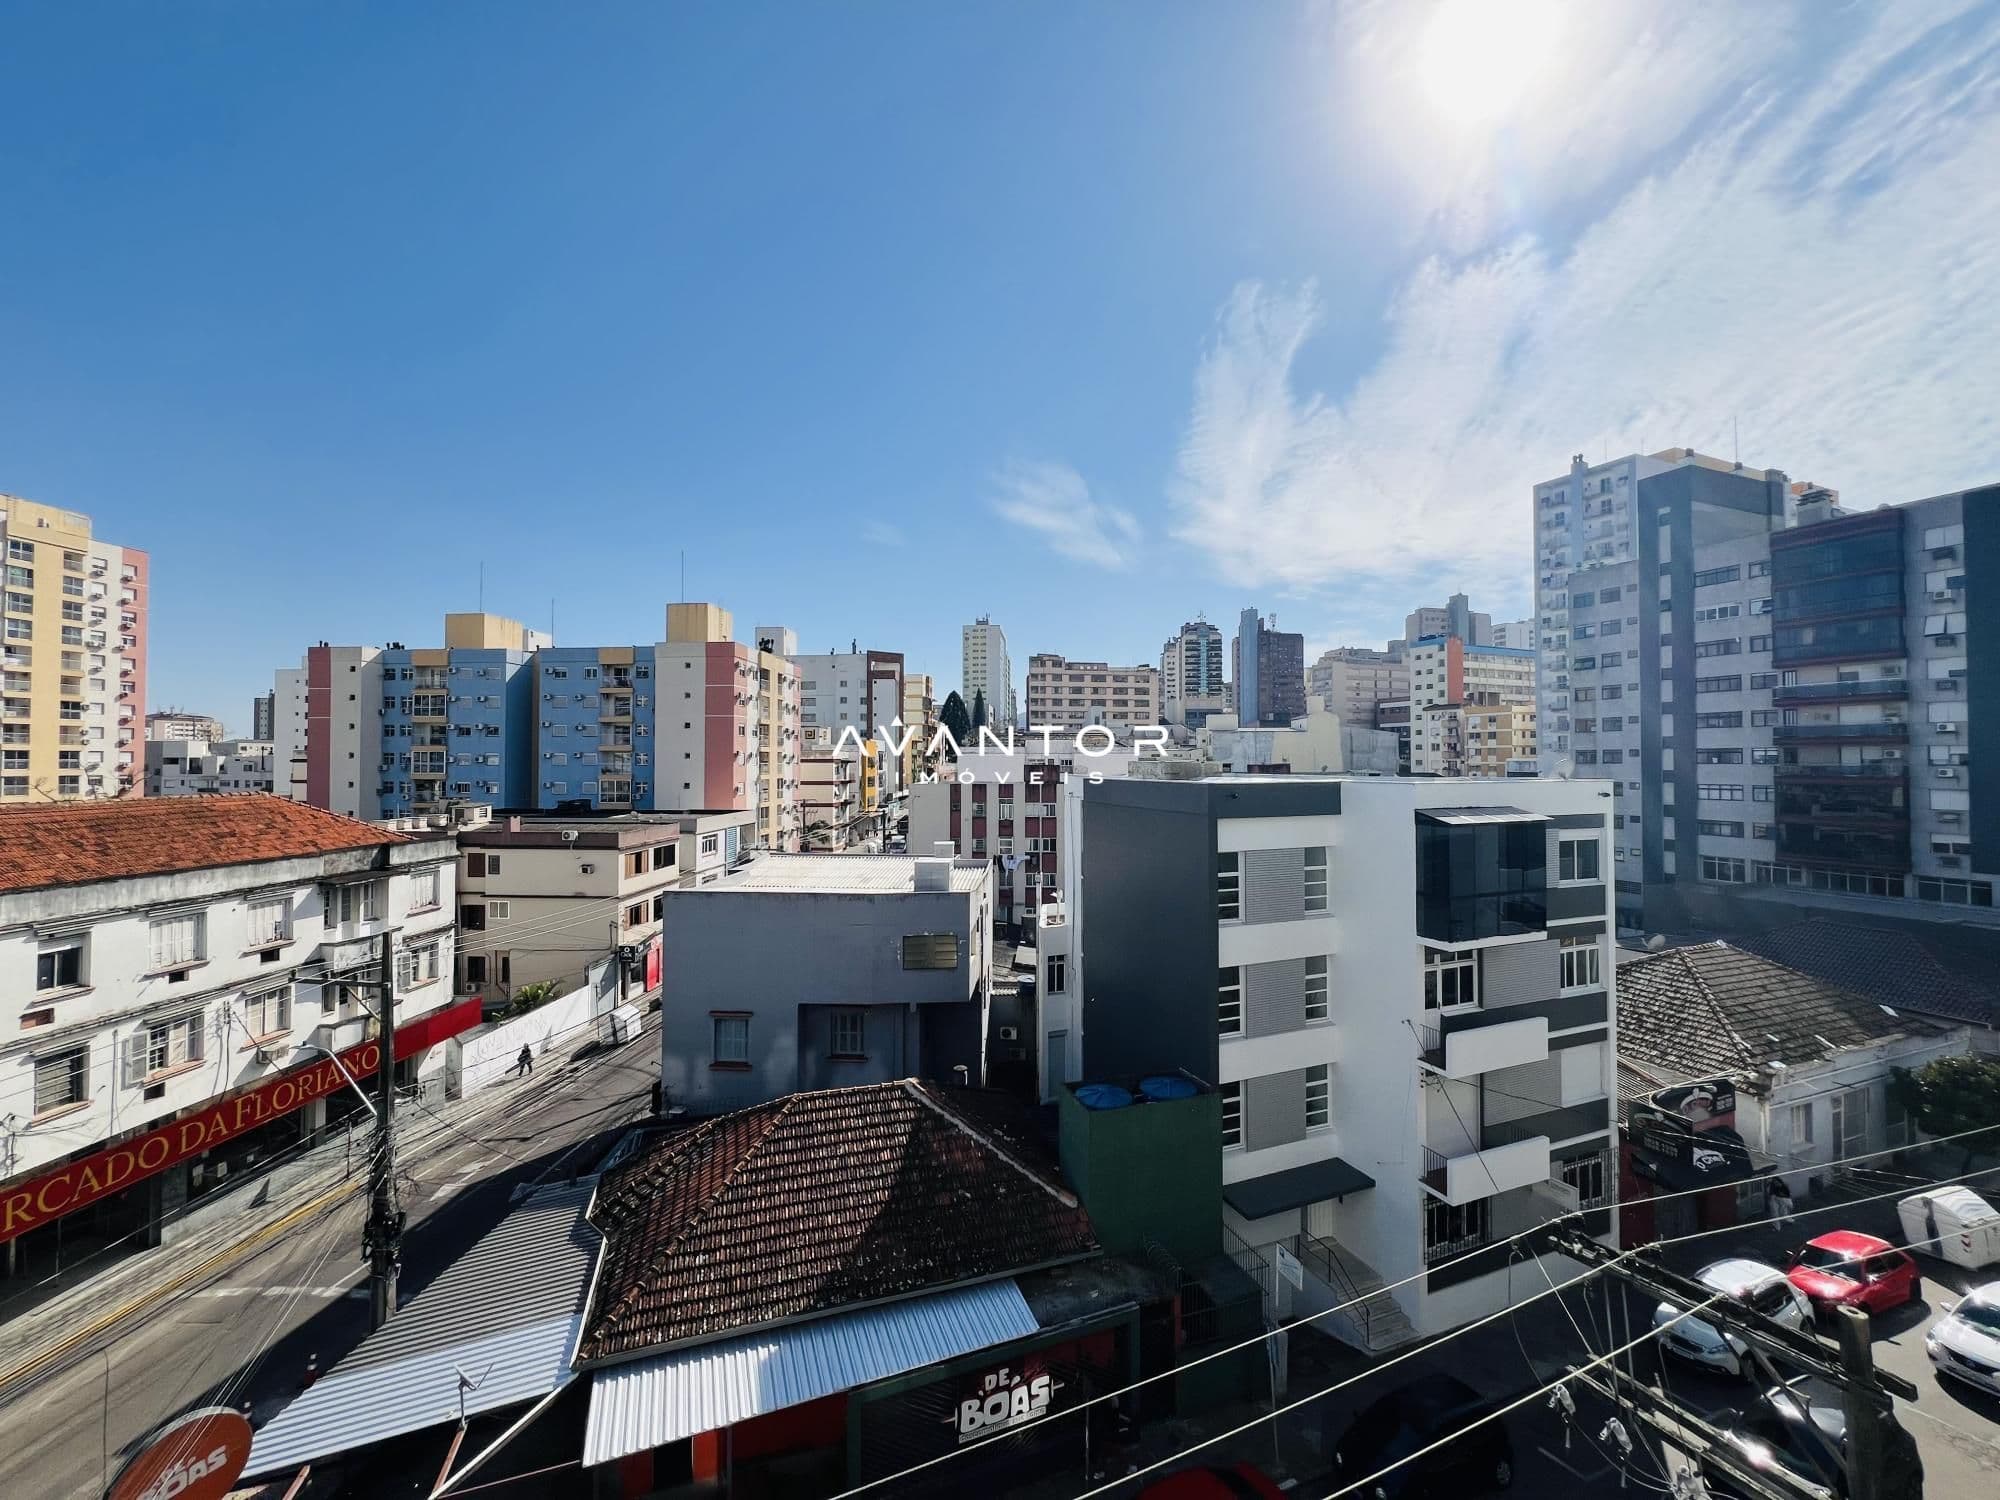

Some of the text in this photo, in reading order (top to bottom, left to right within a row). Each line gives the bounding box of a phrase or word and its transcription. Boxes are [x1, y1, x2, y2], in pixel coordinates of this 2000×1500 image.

[179, 1111, 228, 1154] DA
[234, 1046, 380, 1130] FLORIANO
[984, 1367, 1010, 1391] DE
